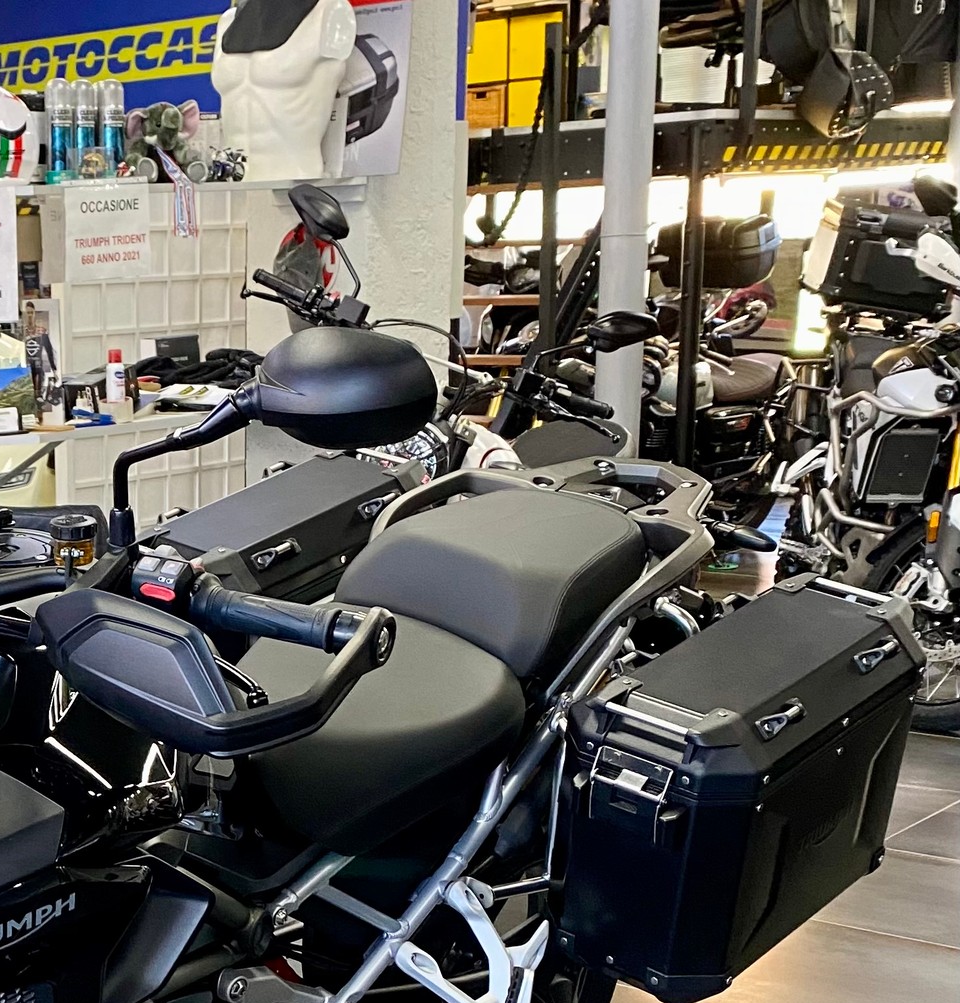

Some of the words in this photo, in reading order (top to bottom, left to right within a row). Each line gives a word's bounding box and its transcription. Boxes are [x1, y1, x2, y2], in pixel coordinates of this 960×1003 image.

[80, 198, 139, 213] OCCASIONE
[74, 236, 110, 249] TRIUMPH
[111, 233, 146, 246] TRIDENT
[81, 254, 95, 265] 660
[96, 252, 121, 263] ANNO
[123, 250, 140, 261] 2021
